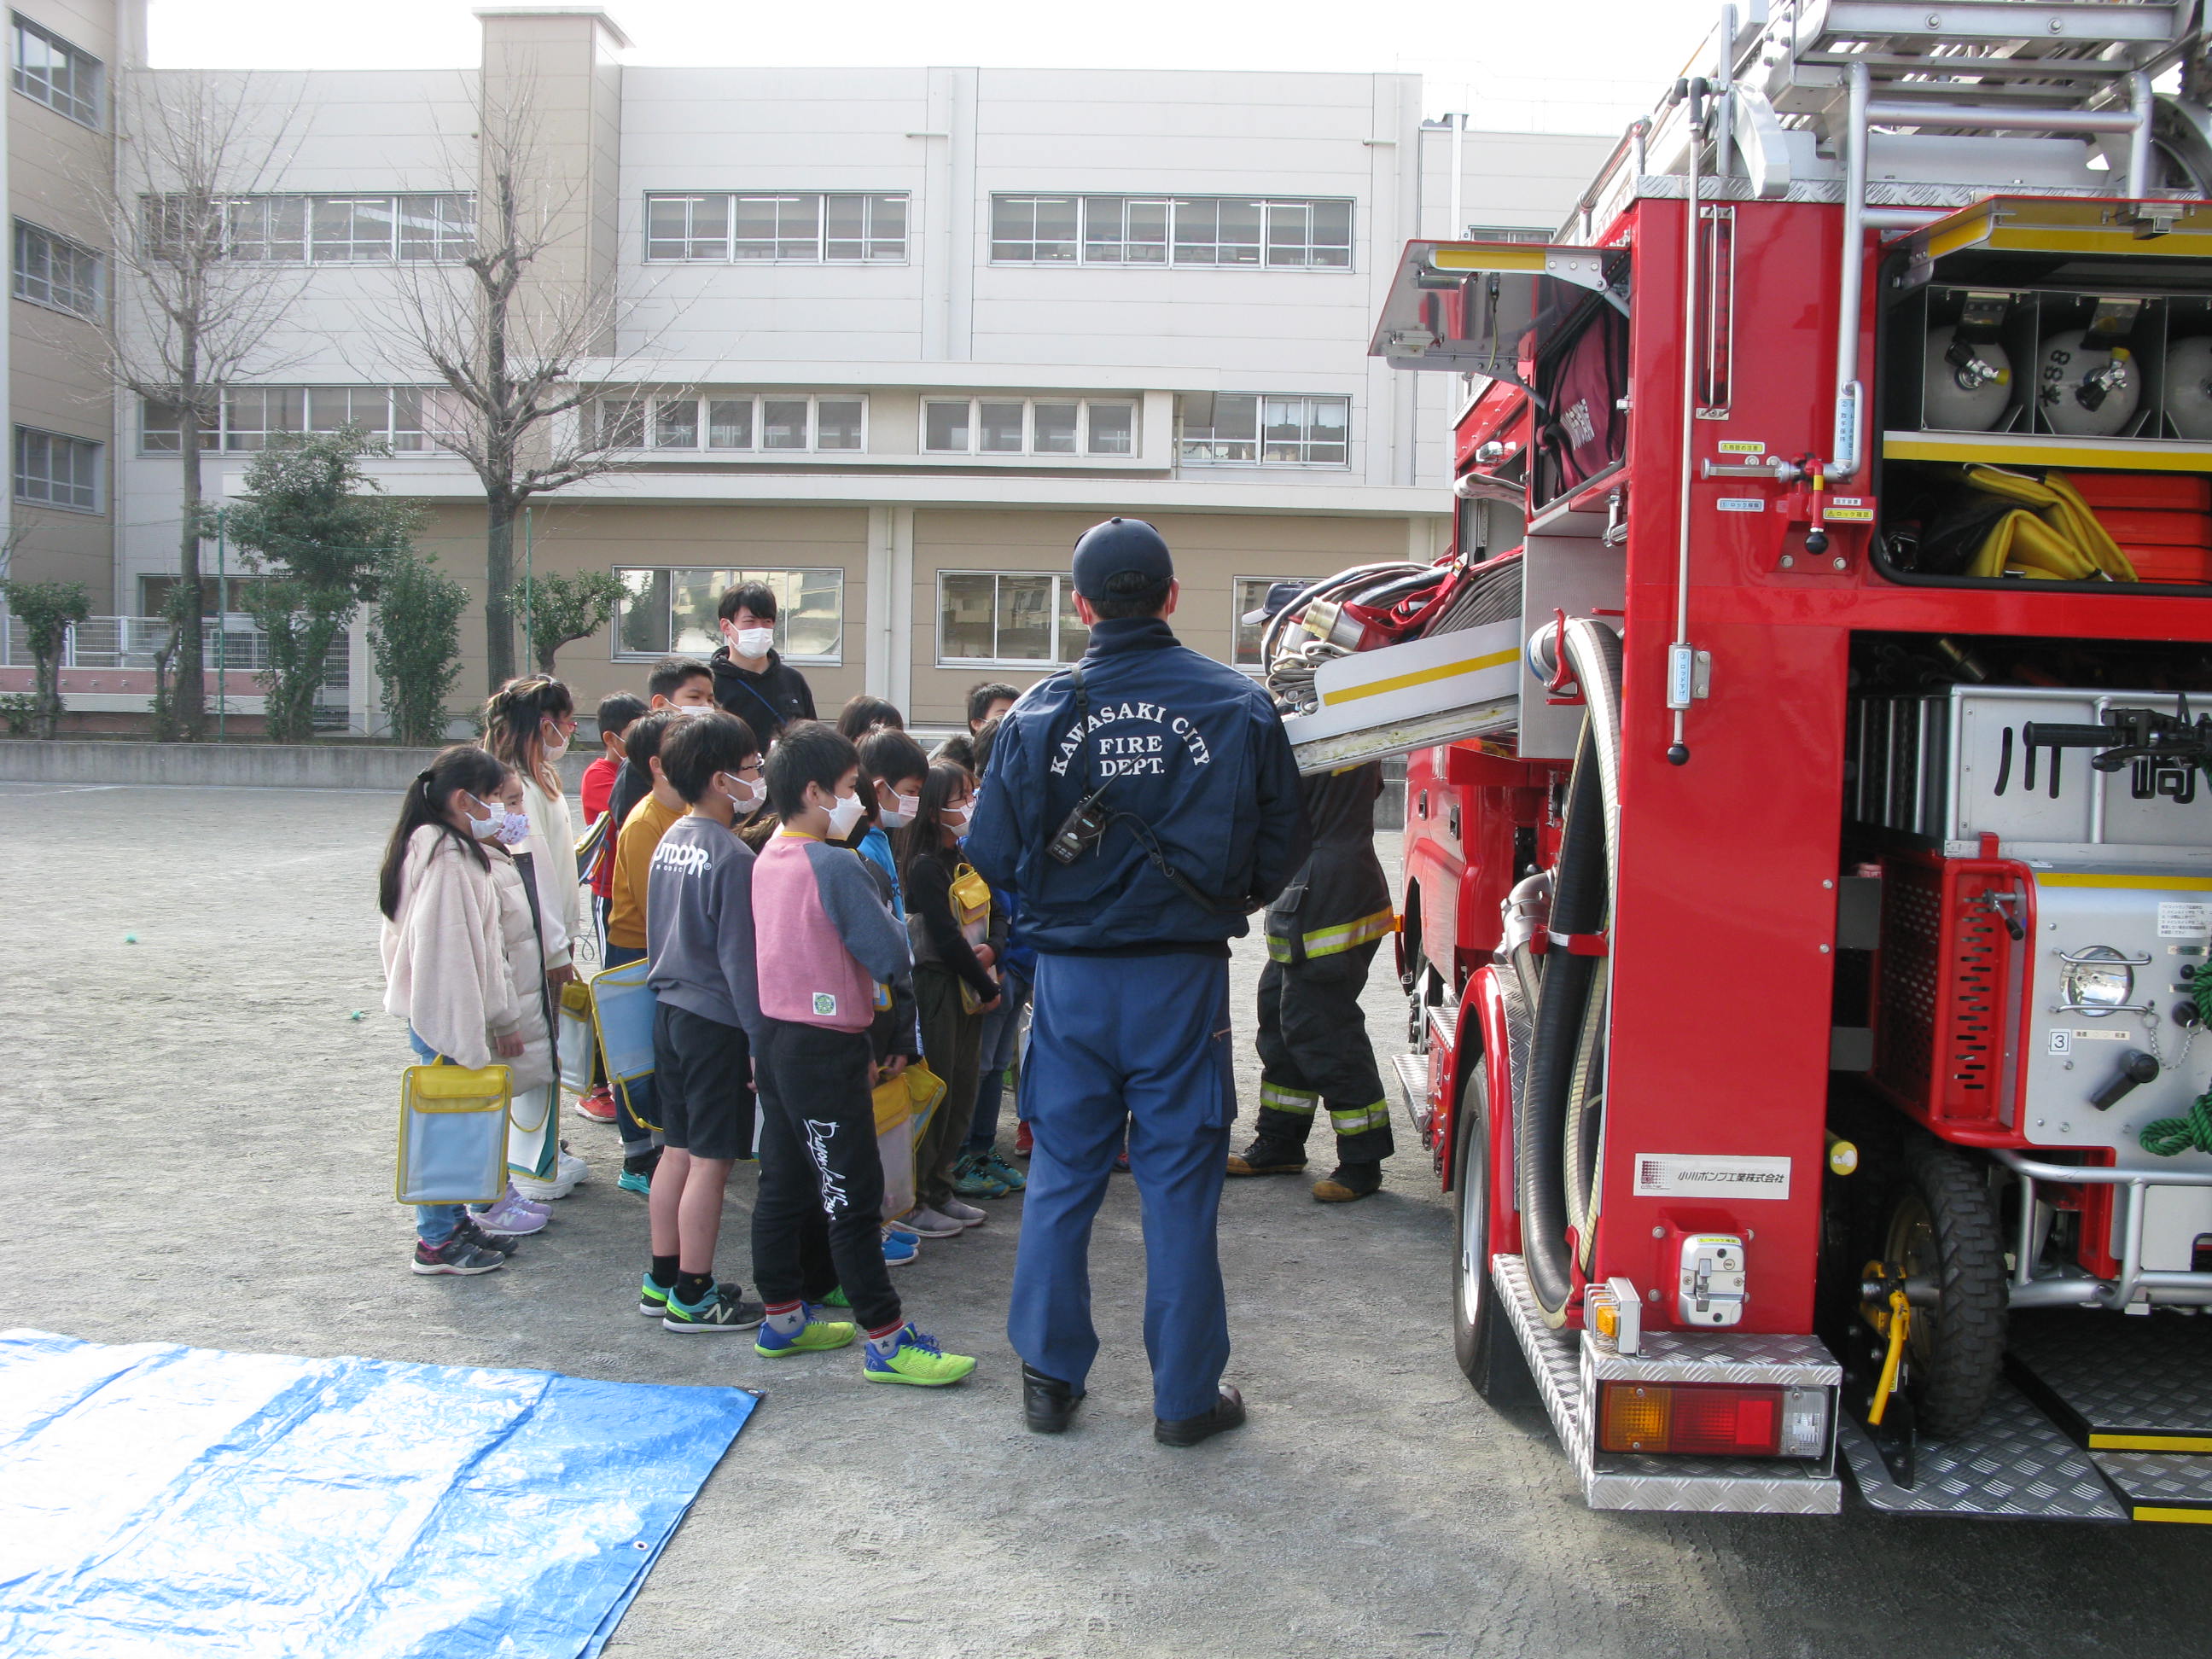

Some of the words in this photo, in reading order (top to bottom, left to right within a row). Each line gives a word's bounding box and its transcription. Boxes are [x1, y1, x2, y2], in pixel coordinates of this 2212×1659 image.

[1051, 702, 1167, 777] KAWASAKI
[1172, 717, 1210, 766] CITY
[1099, 736, 1163, 755] FIRE
[1100, 757, 1165, 777] DEPT.
[2054, 1034, 2064, 1048] 3
[1677, 1171, 1785, 1184] 小川ポンプ工業株式会社
